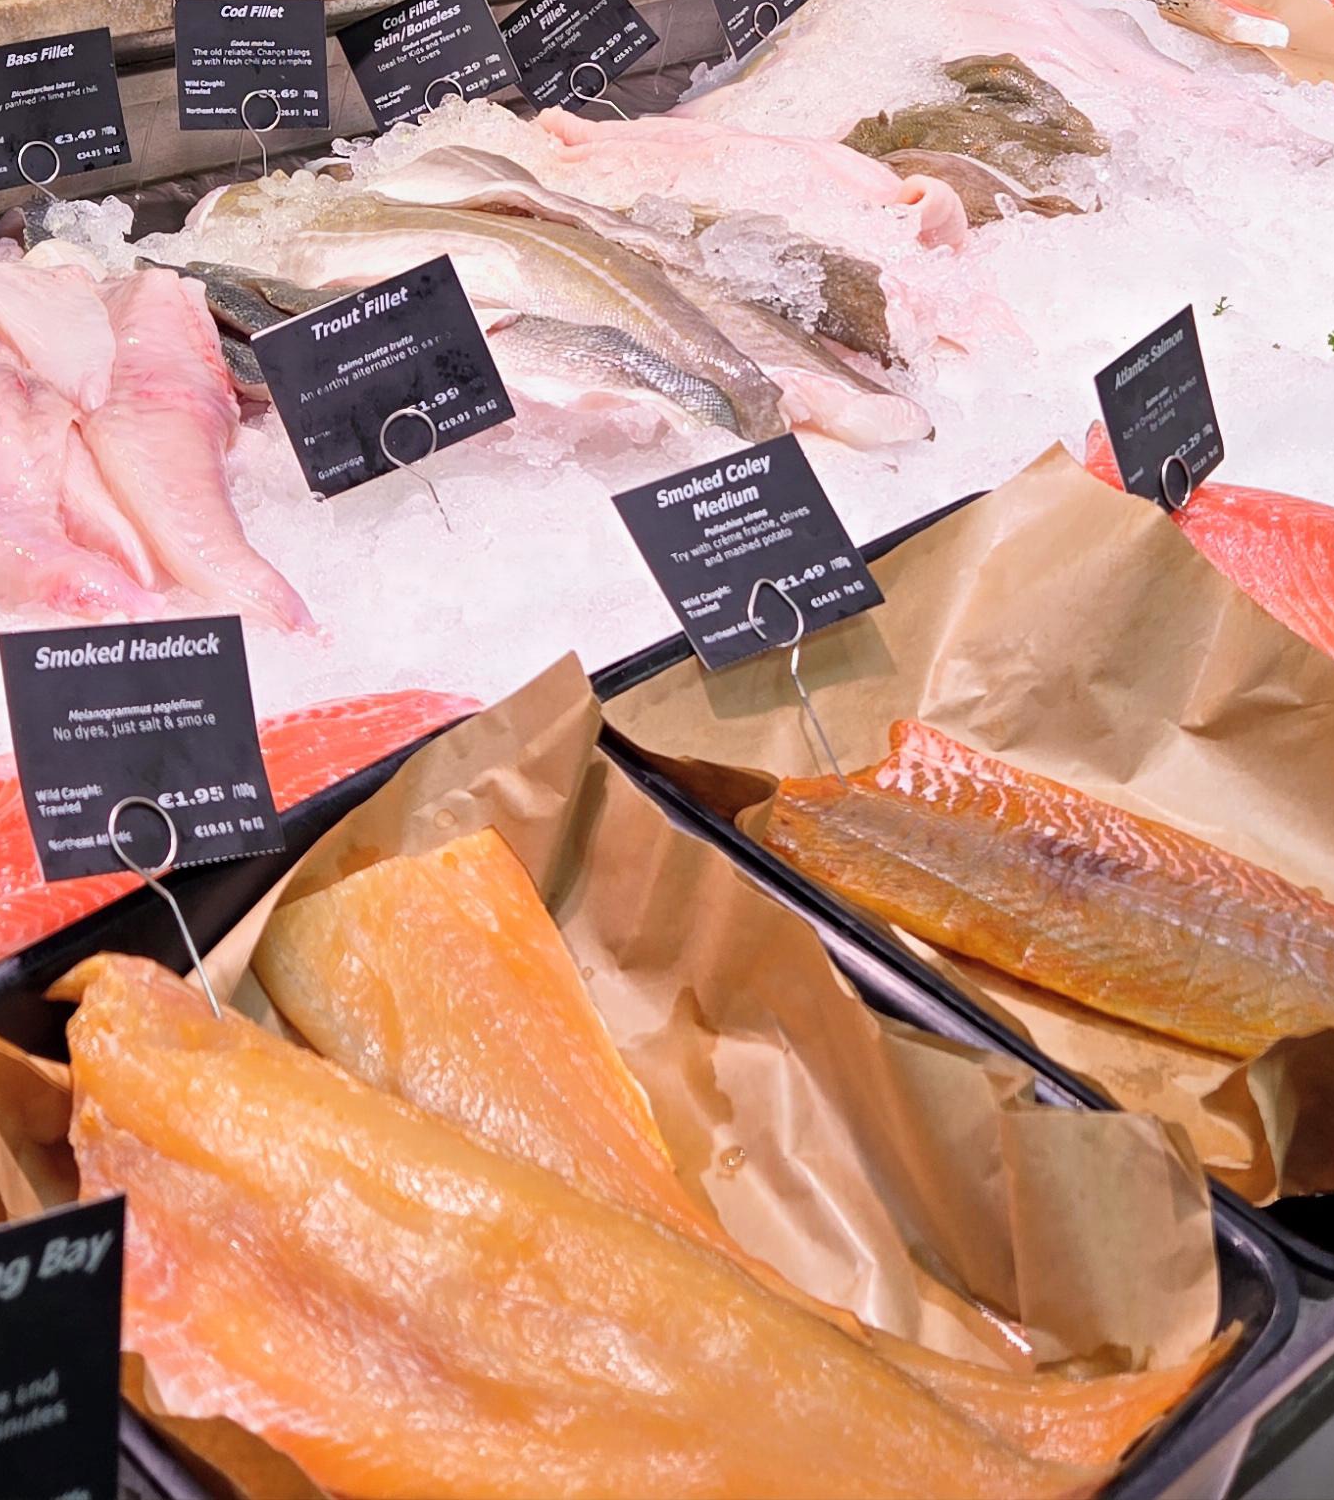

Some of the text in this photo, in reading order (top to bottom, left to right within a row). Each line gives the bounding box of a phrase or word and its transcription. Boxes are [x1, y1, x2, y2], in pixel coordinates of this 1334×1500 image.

[221, 5, 284, 18] Cod Fillet
[382, 13, 406, 31] Cod
[538, 2, 567, 30] Fillet
[373, 4, 461, 52] Skin/Boneless
[501, 15, 531, 43] Fresh
[6, 43, 75, 68] Bass Fillet
[193, 48, 208, 56] The
[210, 48, 222, 56] old
[257, 48, 285, 57] Change
[287, 48, 310, 57] things
[378, 59, 396, 73] Ideal
[397, 53, 408, 64] for
[408, 46, 424, 59] Kids
[426, 40, 439, 50] and
[416, 49, 441, 65] Lovers
[590, 33, 622, 61] €2.59
[48, 92, 65, 101] lime
[67, 89, 80, 97] and
[54, 129, 96, 145] €3.49
[311, 286, 409, 341] Trout Fillet
[337, 355, 364, 374] Salmo
[364, 344, 389, 363] trutta
[389, 334, 415, 352] trutta
[1115, 328, 1184, 391] Atlantic Salmon
[299, 391, 315, 404] An
[351, 350, 407, 381] alternative
[407, 345, 419, 356] to
[655, 454, 772, 509] Smoked Coley
[692, 483, 760, 521] Medium
[670, 505, 811, 564] Try with crème fraiche, chives
[704, 526, 793, 568] and mashed potato
[34, 631, 220, 672] Smoked Haddock
[52, 715, 175, 741] No dyes, just salt &
[35, 787, 60, 803] Wild
[157, 786, 225, 811] €1.95
[35, 1227, 116, 1281] Bay
